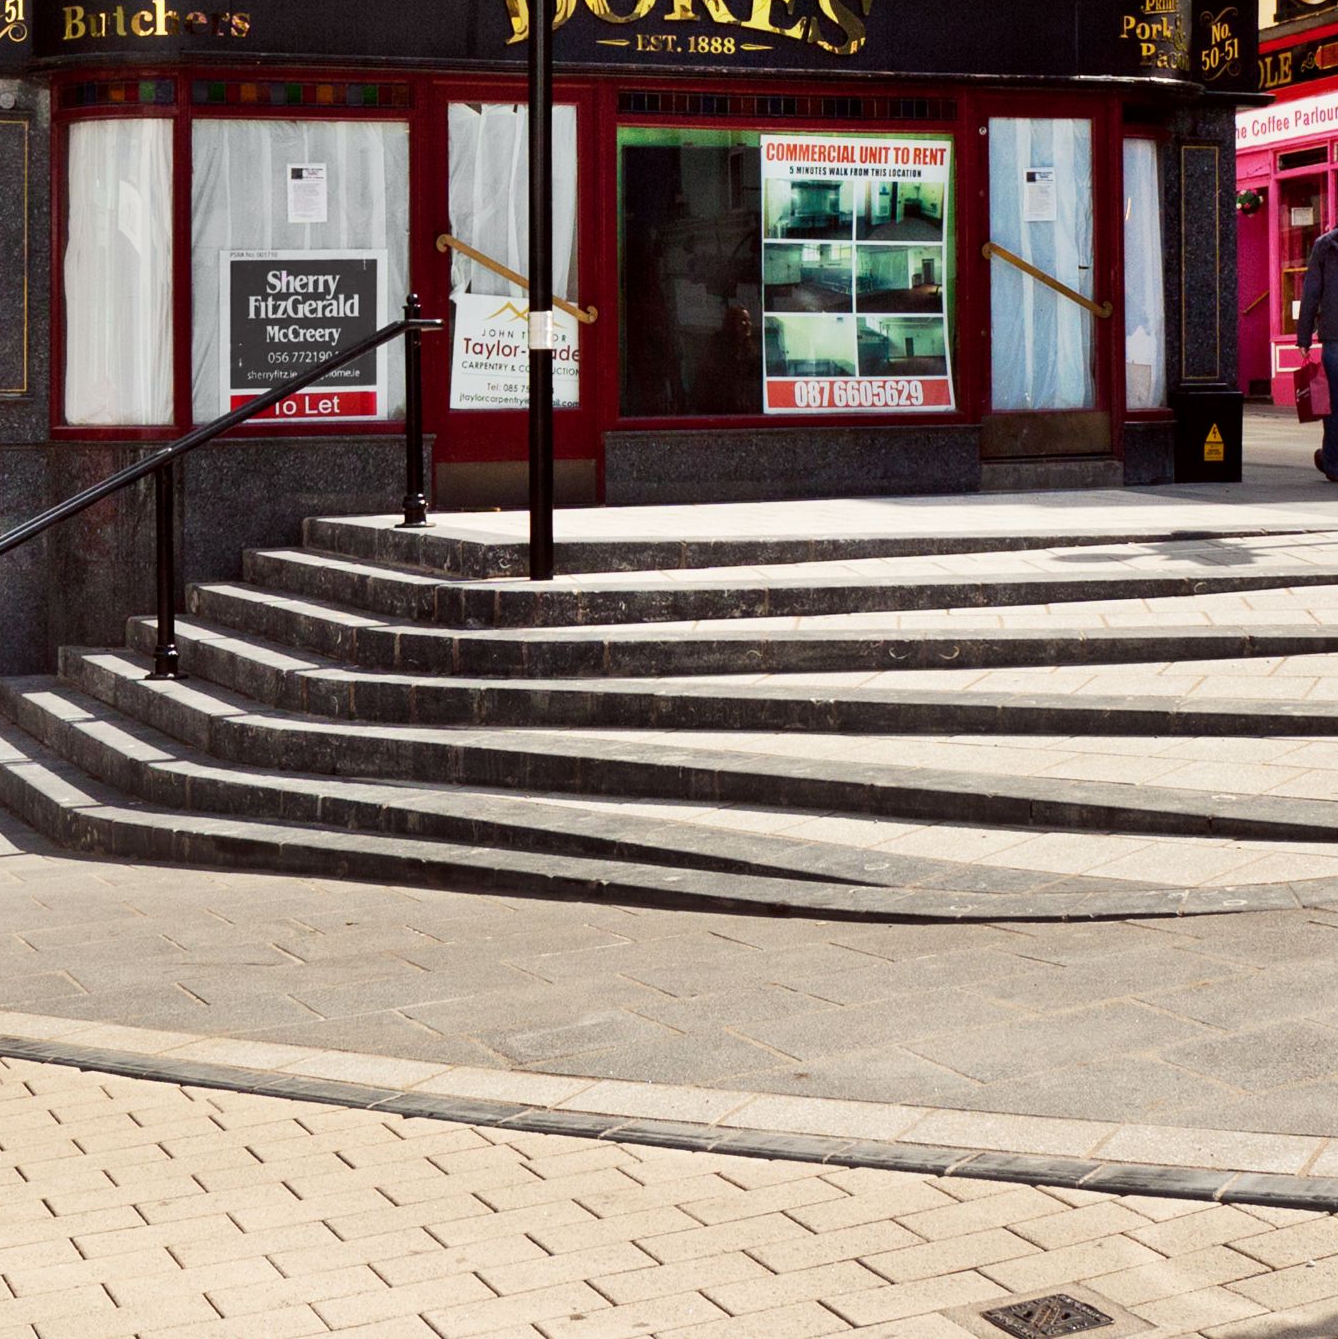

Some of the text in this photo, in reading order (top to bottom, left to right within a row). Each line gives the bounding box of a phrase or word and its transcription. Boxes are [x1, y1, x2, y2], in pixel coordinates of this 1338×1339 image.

[1119, 15, 1173, 40] Pork
[1211, 22, 1232, 45] No.
[636, 34, 736, 54] EST. 1888
[1201, 38, 1239, 71] 50-51
[1258, 52, 1293, 90] LE
[1252, 115, 1290, 136] Coffee
[1295, 106, 1338, 128] Parlour
[765, 142, 947, 166] COMMERCIAL UNIT TO RENT
[789, 166, 922, 178] 5 MINUTES WALK FROM THIS LOCATION
[265, 270, 341, 300] Sherry
[247, 294, 361, 320] FitzGerald
[265, 324, 342, 346] McCreery
[481, 328, 514, 338] JOHN
[267, 352, 289, 363] 056
[461, 361, 508, 372] CARPENTRY
[511, 364, 515, 372] &
[503, 384, 518, 393] 085
[794, 380, 924, 407] 087 6605629
[304, 396, 340, 414] Let
